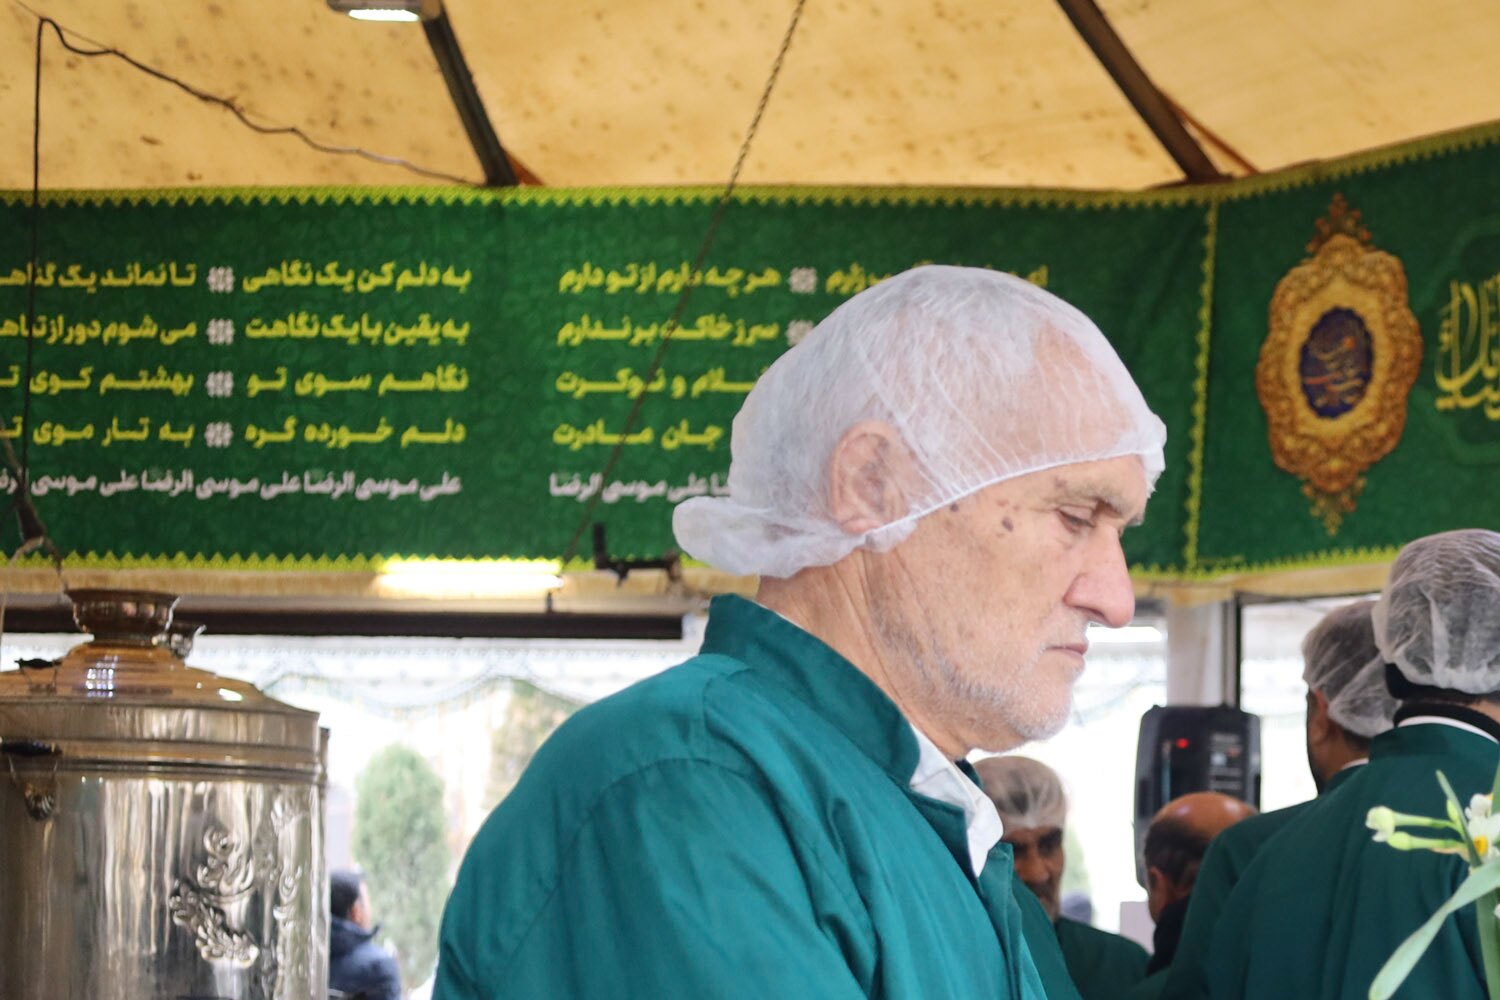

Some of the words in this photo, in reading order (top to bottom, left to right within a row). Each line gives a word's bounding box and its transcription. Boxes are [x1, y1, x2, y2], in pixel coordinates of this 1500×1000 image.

[58, 264, 97, 294] یک
[100, 261, 168, 287] نماند
[169, 262, 197, 287] تا
[242, 259, 313, 293] نگاهی
[315, 261, 355, 293] یک
[357, 260, 396, 293] کن
[395, 260, 440, 293] دلم
[442, 264, 472, 293] به
[559, 261, 606, 295] دارم
[605, 262, 639, 295] تو
[636, 261, 657, 295] از
[656, 261, 702, 295] دارم
[46, 314, 65, 346] از
[63, 320, 101, 346] دور
[102, 314, 158, 346] شوم
[160, 322, 197, 346] می
[245, 311, 321, 339] نگاهت
[321, 314, 360, 346] یک
[361, 313, 383, 346] با
[383, 313, 441, 346] یقین
[441, 318, 470, 346] به
[660, 313, 733, 340] خاکت
[748, 322, 779, 347] سر
[0, 365, 20, 389] ت
[29, 366, 94, 396] کوی
[99, 365, 195, 397] بهشتم
[246, 366, 288, 398] تو
[295, 371, 373, 398] سوی
[378, 363, 469, 397] نگاهم
[556, 367, 667, 399] نوکرت
[671, 374, 687, 399] و
[0, 415, 23, 439] ت
[32, 420, 95, 446] موی
[102, 416, 150, 447] تار
[159, 421, 195, 449] به
[245, 415, 297, 449] گره
[304, 416, 394, 449] خورده
[401, 417, 467, 449] دلم
[553, 418, 654, 451] مادرت
[661, 419, 724, 451] جان
[31, 475, 97, 497] موسی
[99, 469, 139, 497] علی
[141, 468, 194, 497] الرضا
[195, 476, 259, 500] موسی
[260, 471, 302, 500] علی
[303, 471, 355, 500] الرضا
[355, 476, 419, 500] موسی
[419, 471, 461, 501] علی
[549, 472, 603, 502] الرضا
[602, 479, 668, 503] موسی
